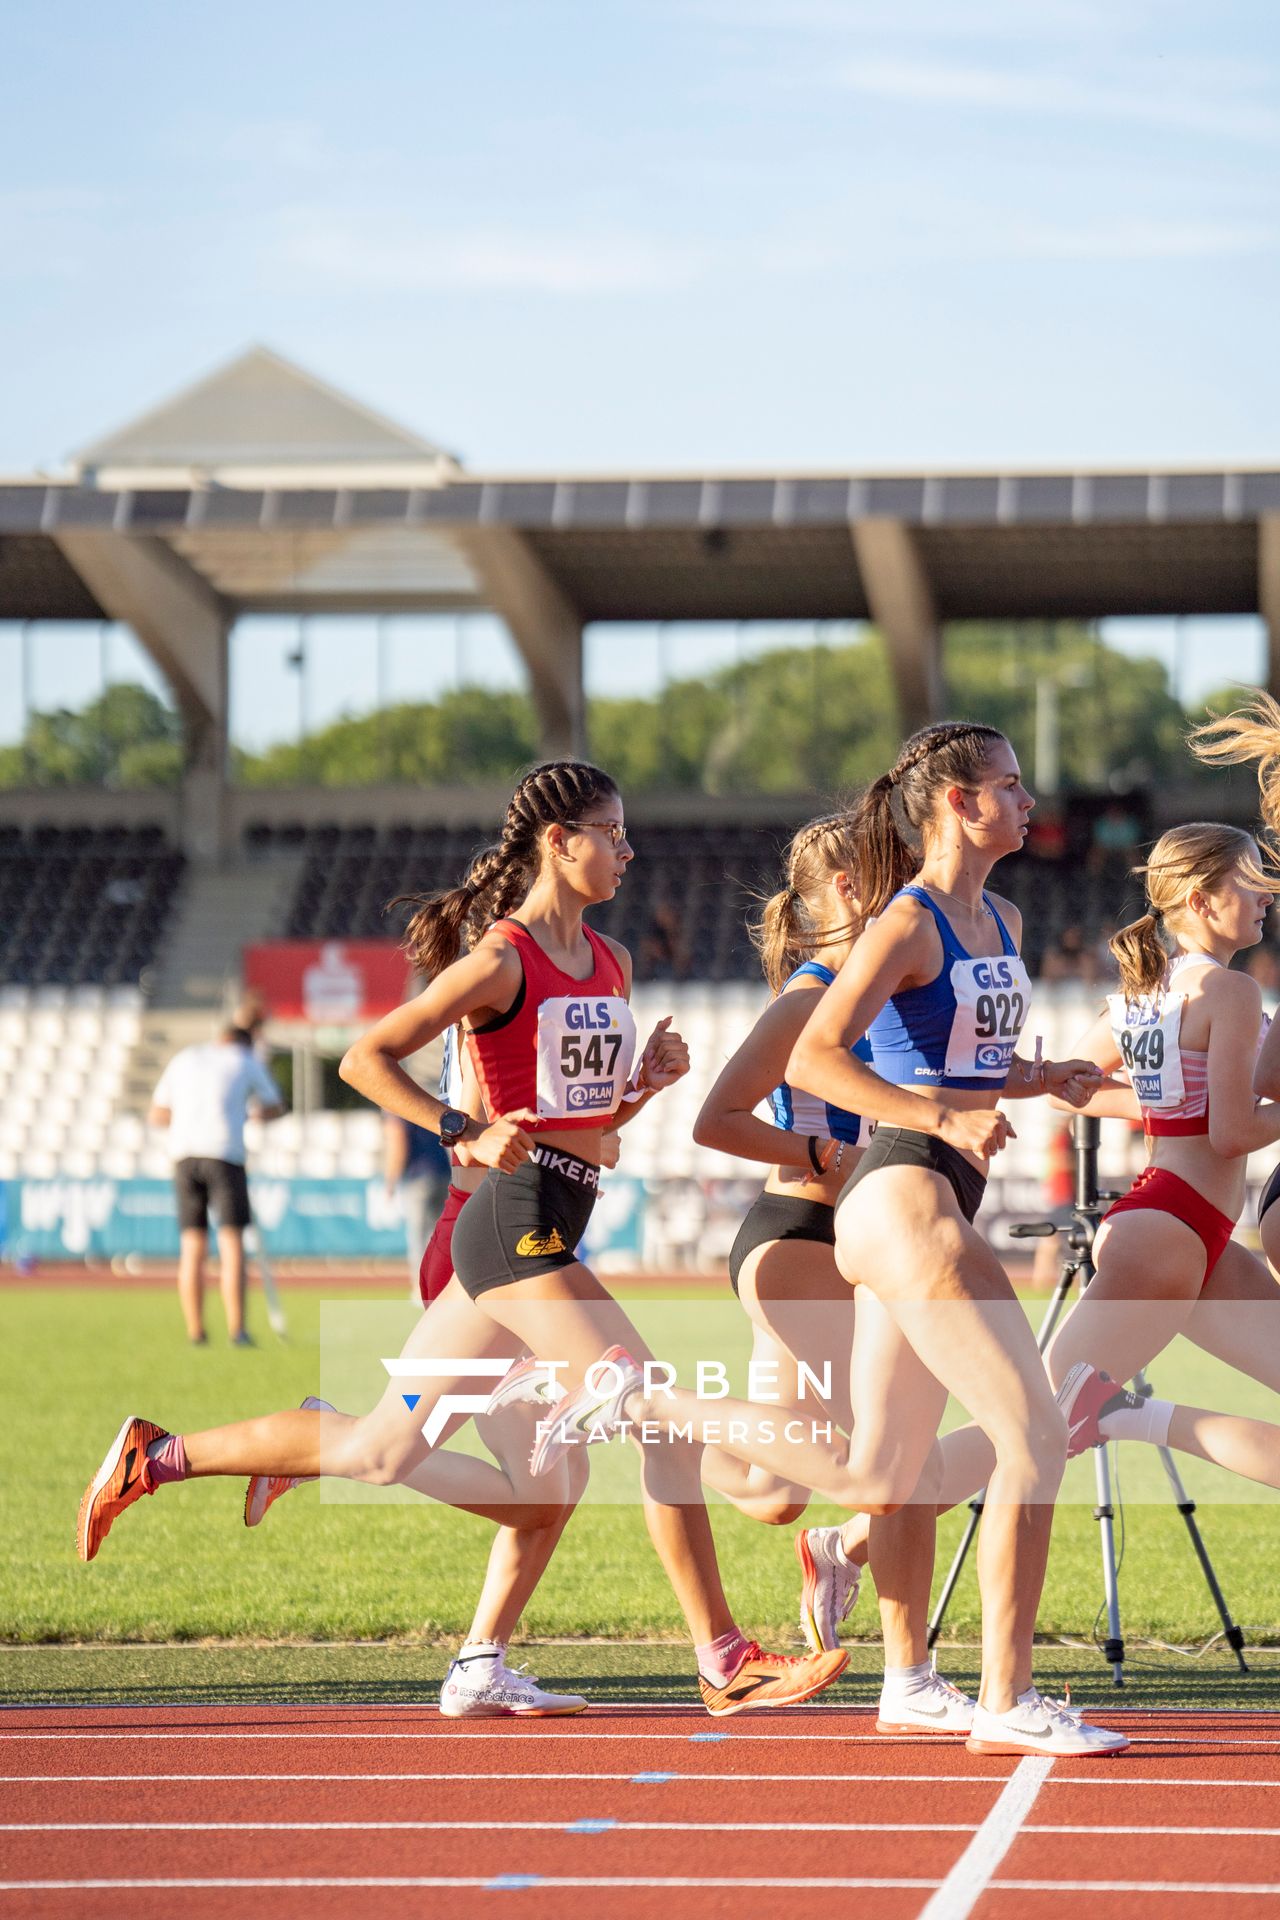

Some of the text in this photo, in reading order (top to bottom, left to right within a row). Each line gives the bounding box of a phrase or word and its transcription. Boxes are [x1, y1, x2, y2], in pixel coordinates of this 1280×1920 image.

[975, 992, 1024, 1038] 922
[560, 1034, 622, 1078] 547
[1121, 1029, 1164, 1069] 849
[914, 1067, 945, 1076] CRAF
[589, 1086, 613, 1100] PLAN
[460, 1687, 535, 1704] new balance
